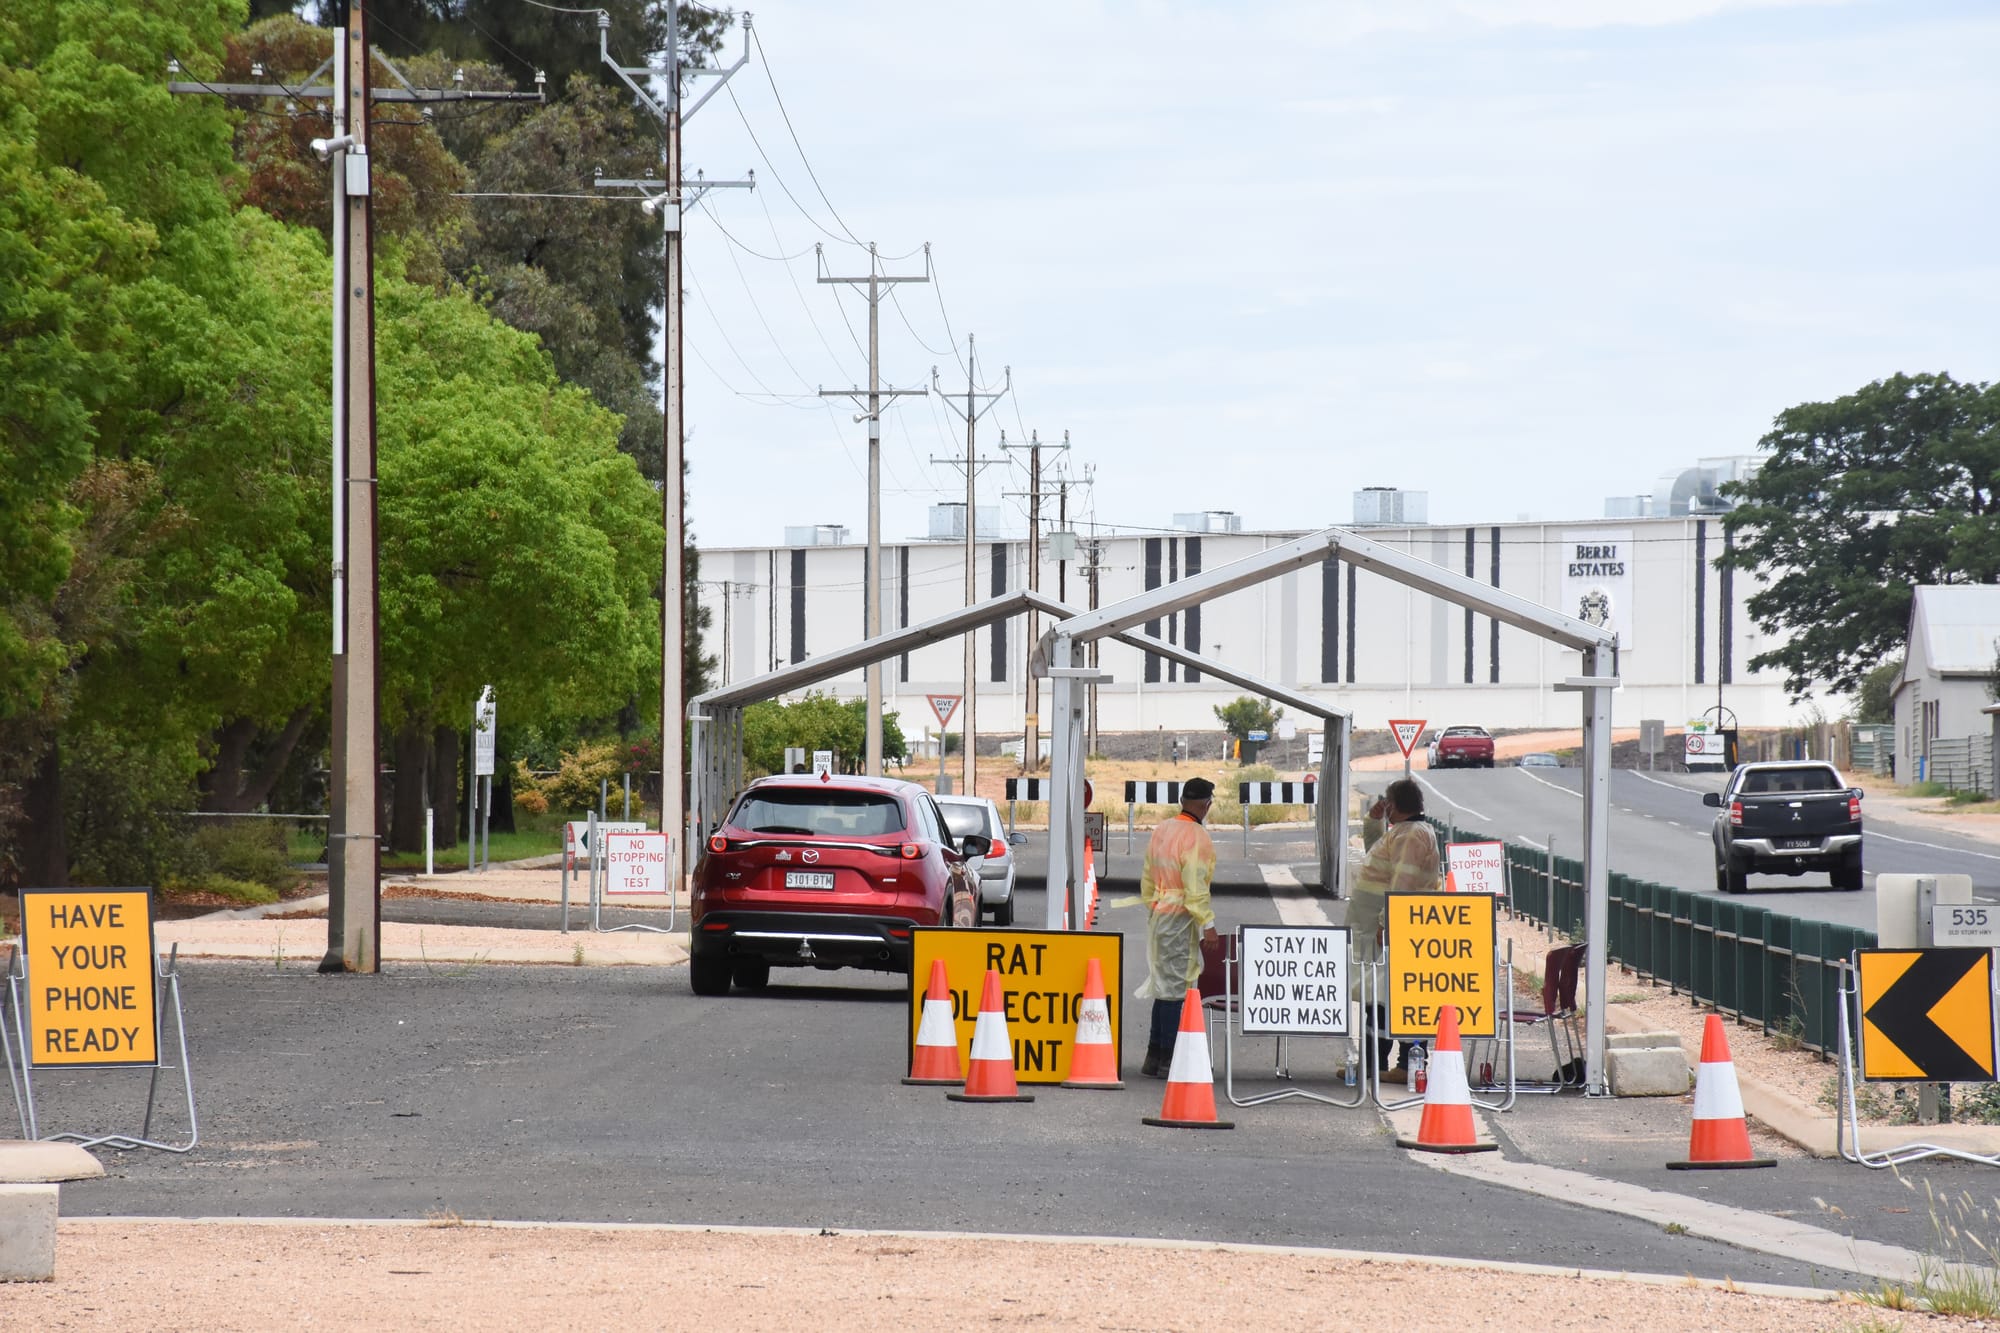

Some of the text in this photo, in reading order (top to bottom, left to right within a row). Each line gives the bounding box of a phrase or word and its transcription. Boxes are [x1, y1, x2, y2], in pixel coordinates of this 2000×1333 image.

[1576, 545, 1616, 560] BERRI
[1568, 562, 1625, 577] ESTATES
[1689, 740, 1701, 748] 40
[597, 828, 640, 836] TUDENT
[630, 840, 645, 849] NO
[1468, 849, 1481, 857] NO
[610, 852, 664, 862] STOPPING
[1452, 859, 1499, 870] STOPPING
[630, 865, 644, 875] TO
[1471, 871, 1483, 880] TO
[624, 878, 650, 888] TEST
[1466, 882, 1488, 892] TEST
[51, 904, 124, 928] HAVE
[1409, 905, 1472, 925] HAVE
[1952, 909, 1988, 926] 535
[1264, 936, 1328, 954] STAY IN
[1410, 938, 1473, 959] YOUR
[52, 945, 126, 970] YOUR
[986, 943, 1047, 976] RAT
[1254, 960, 1336, 978] YOUR CAR
[1403, 972, 1480, 993] PHONE
[46, 986, 136, 1011] PHONE
[1253, 984, 1337, 1002] AND WEAR
[1247, 1007, 1343, 1026] YOUR MASK
[46, 1027, 139, 1052] READY
[970, 1038, 1062, 1072] INT
